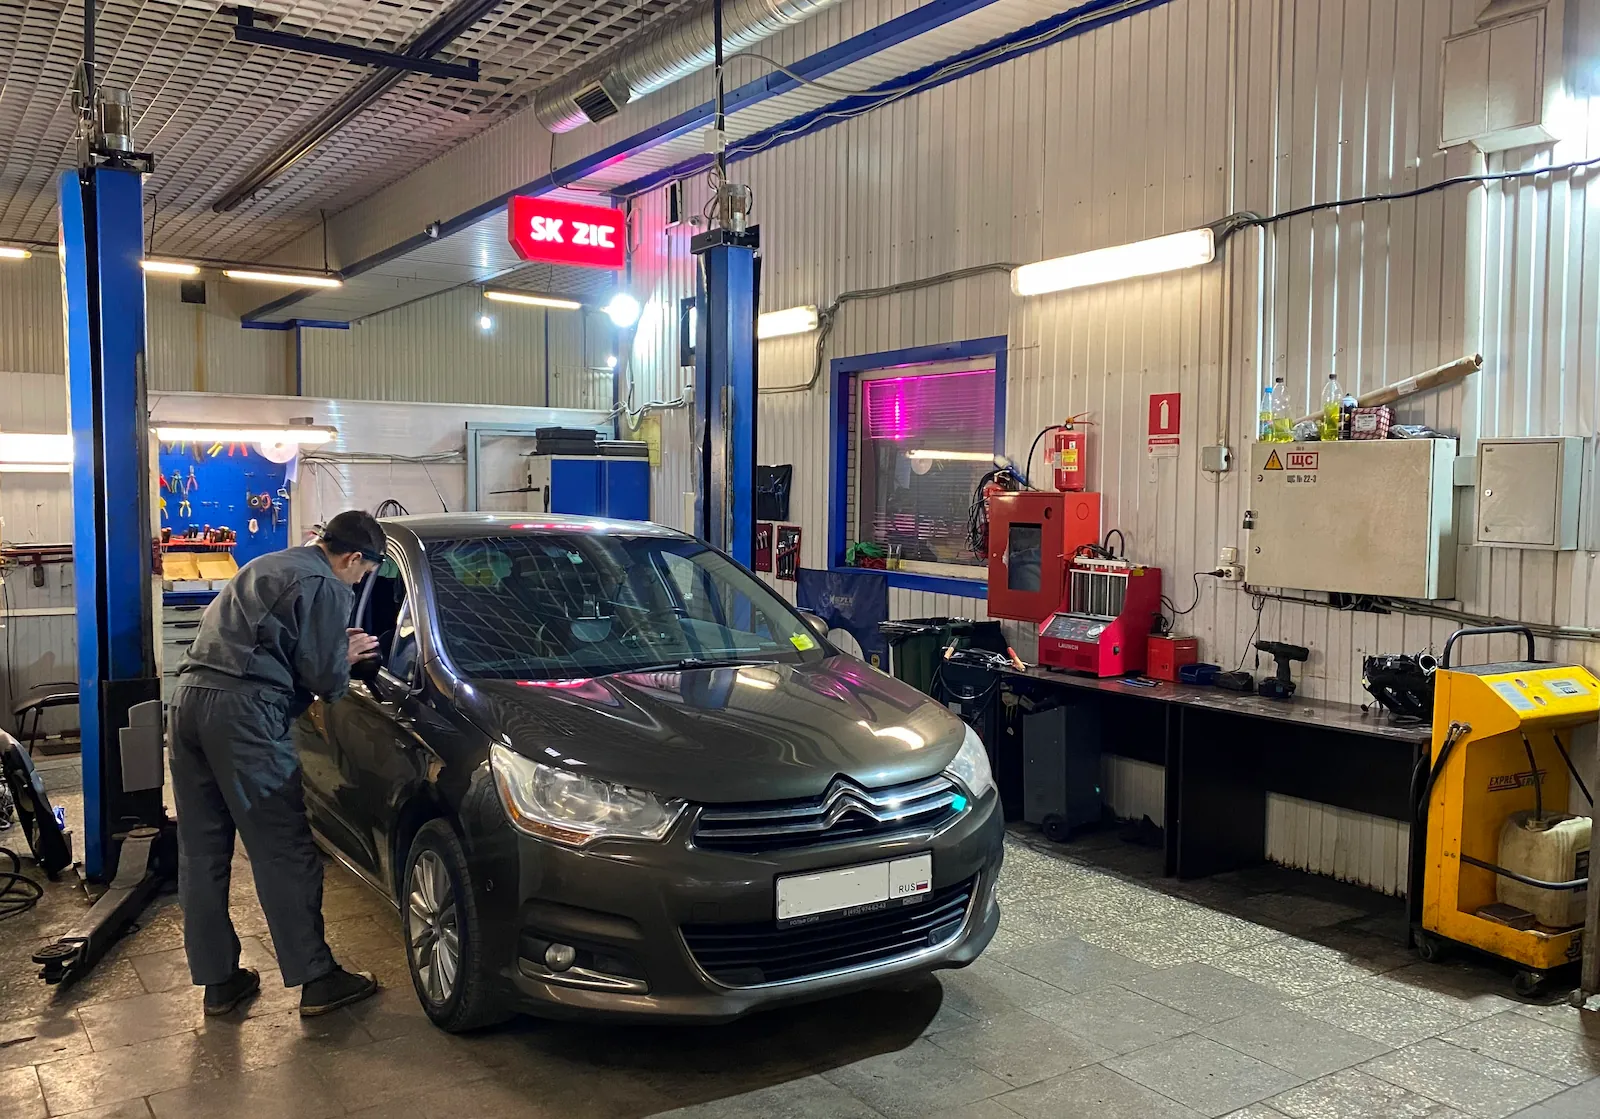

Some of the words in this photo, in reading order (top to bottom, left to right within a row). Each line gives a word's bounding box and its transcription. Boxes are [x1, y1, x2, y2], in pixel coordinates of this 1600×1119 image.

[530, 215, 564, 243] SK
[571, 221, 616, 248] ZIC
[1291, 455, 1313, 467] ЩС
[1303, 474, 1317, 483] 22-3
[1057, 642, 1079, 651] LAUNCH
[898, 883, 916, 893] RUS
